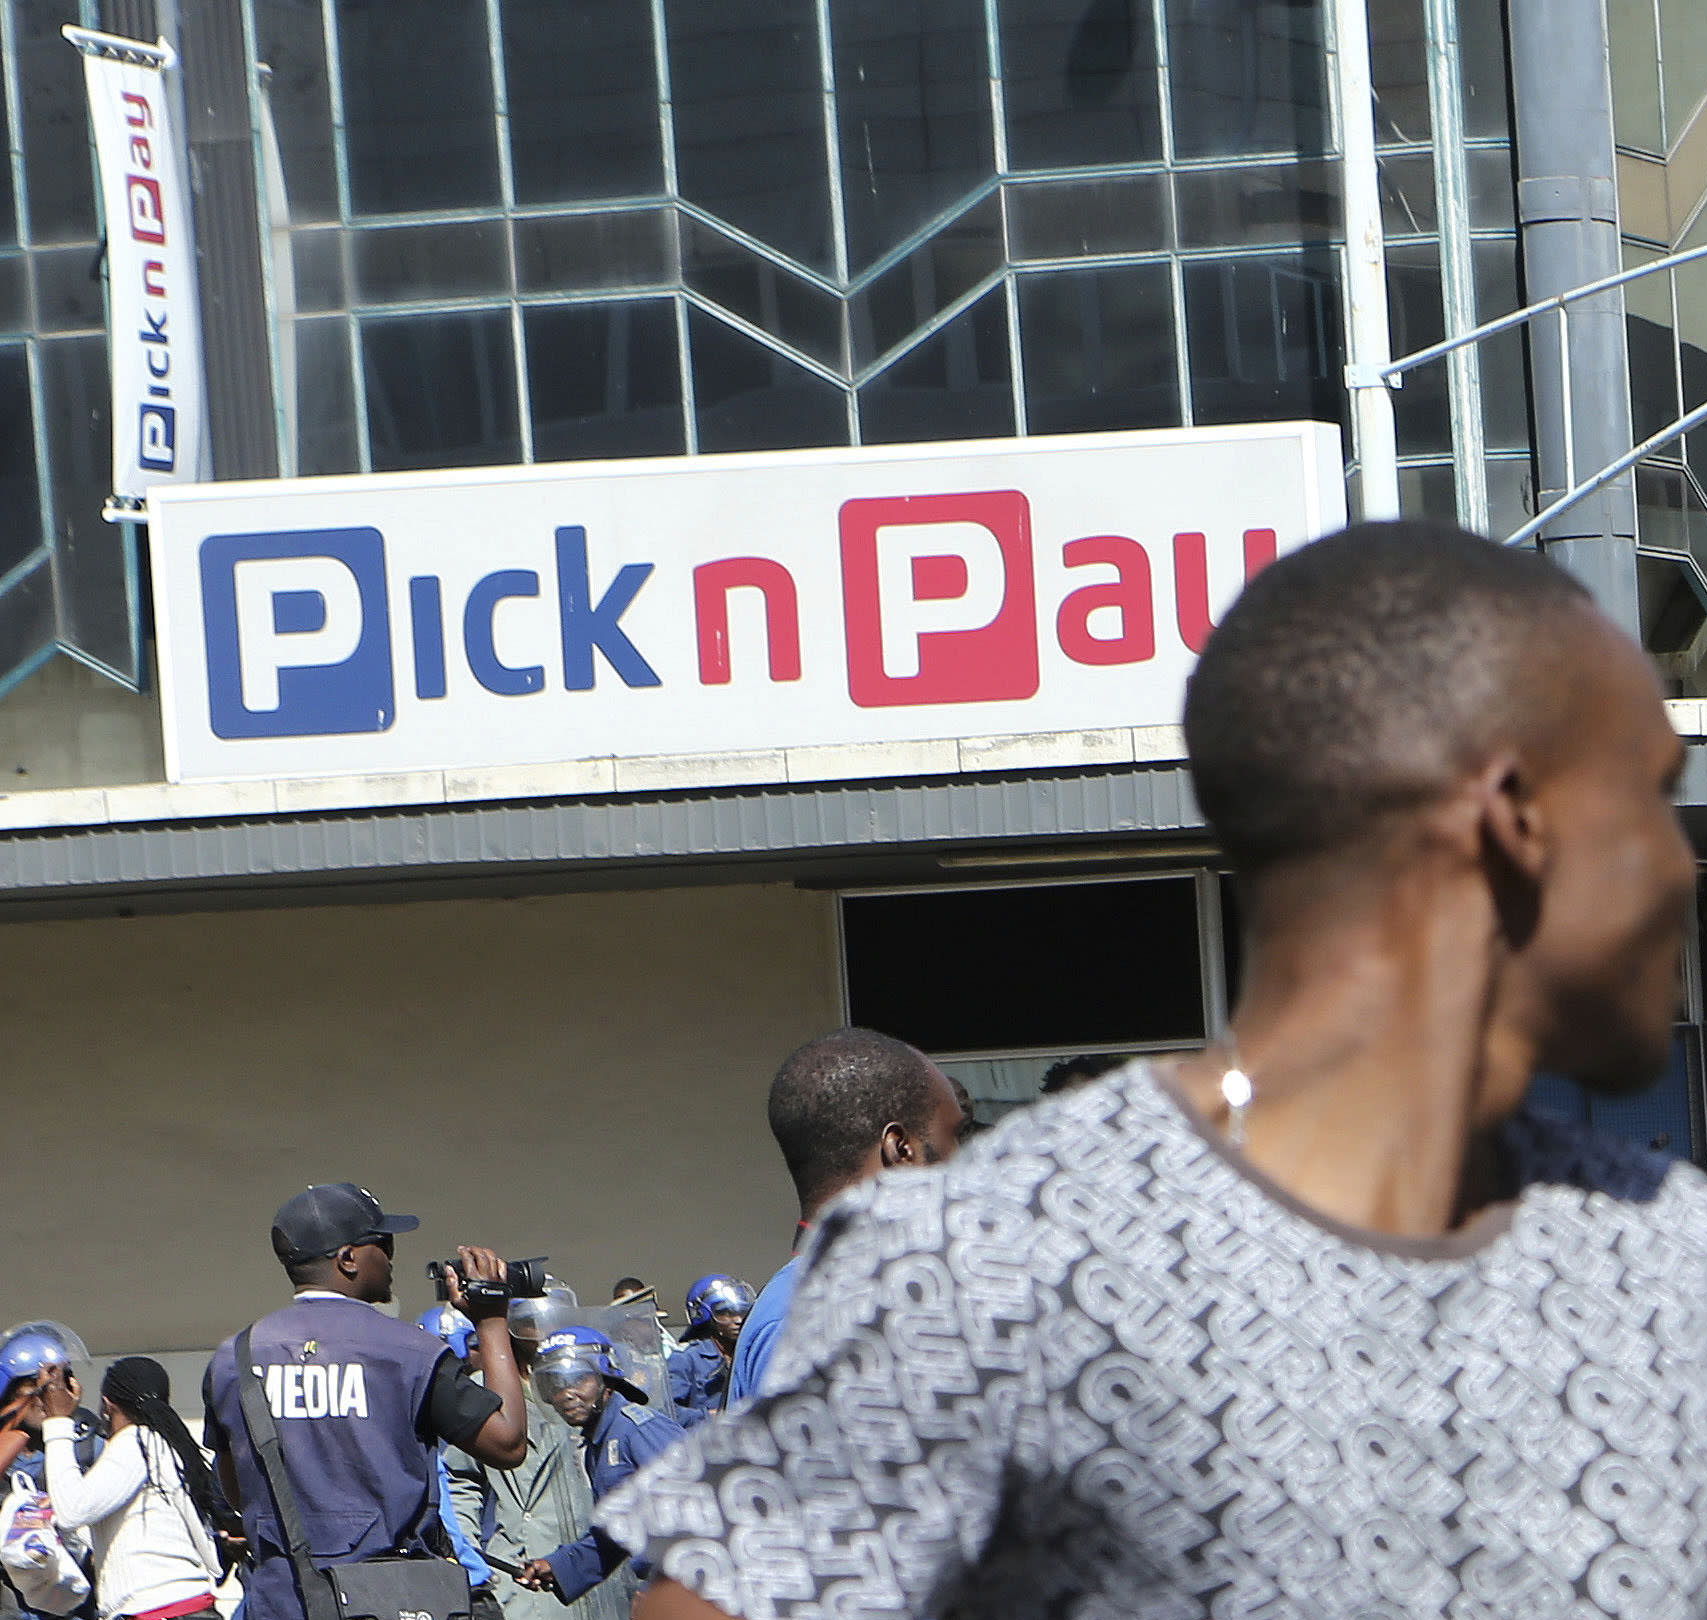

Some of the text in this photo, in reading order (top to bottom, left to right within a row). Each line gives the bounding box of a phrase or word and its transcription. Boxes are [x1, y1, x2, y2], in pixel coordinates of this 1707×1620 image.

[121, 90, 177, 472] Pick n Pay
[199, 525, 662, 741] Pick
[692, 556, 803, 686] n
[252, 1363, 369, 1419] MEDIA
